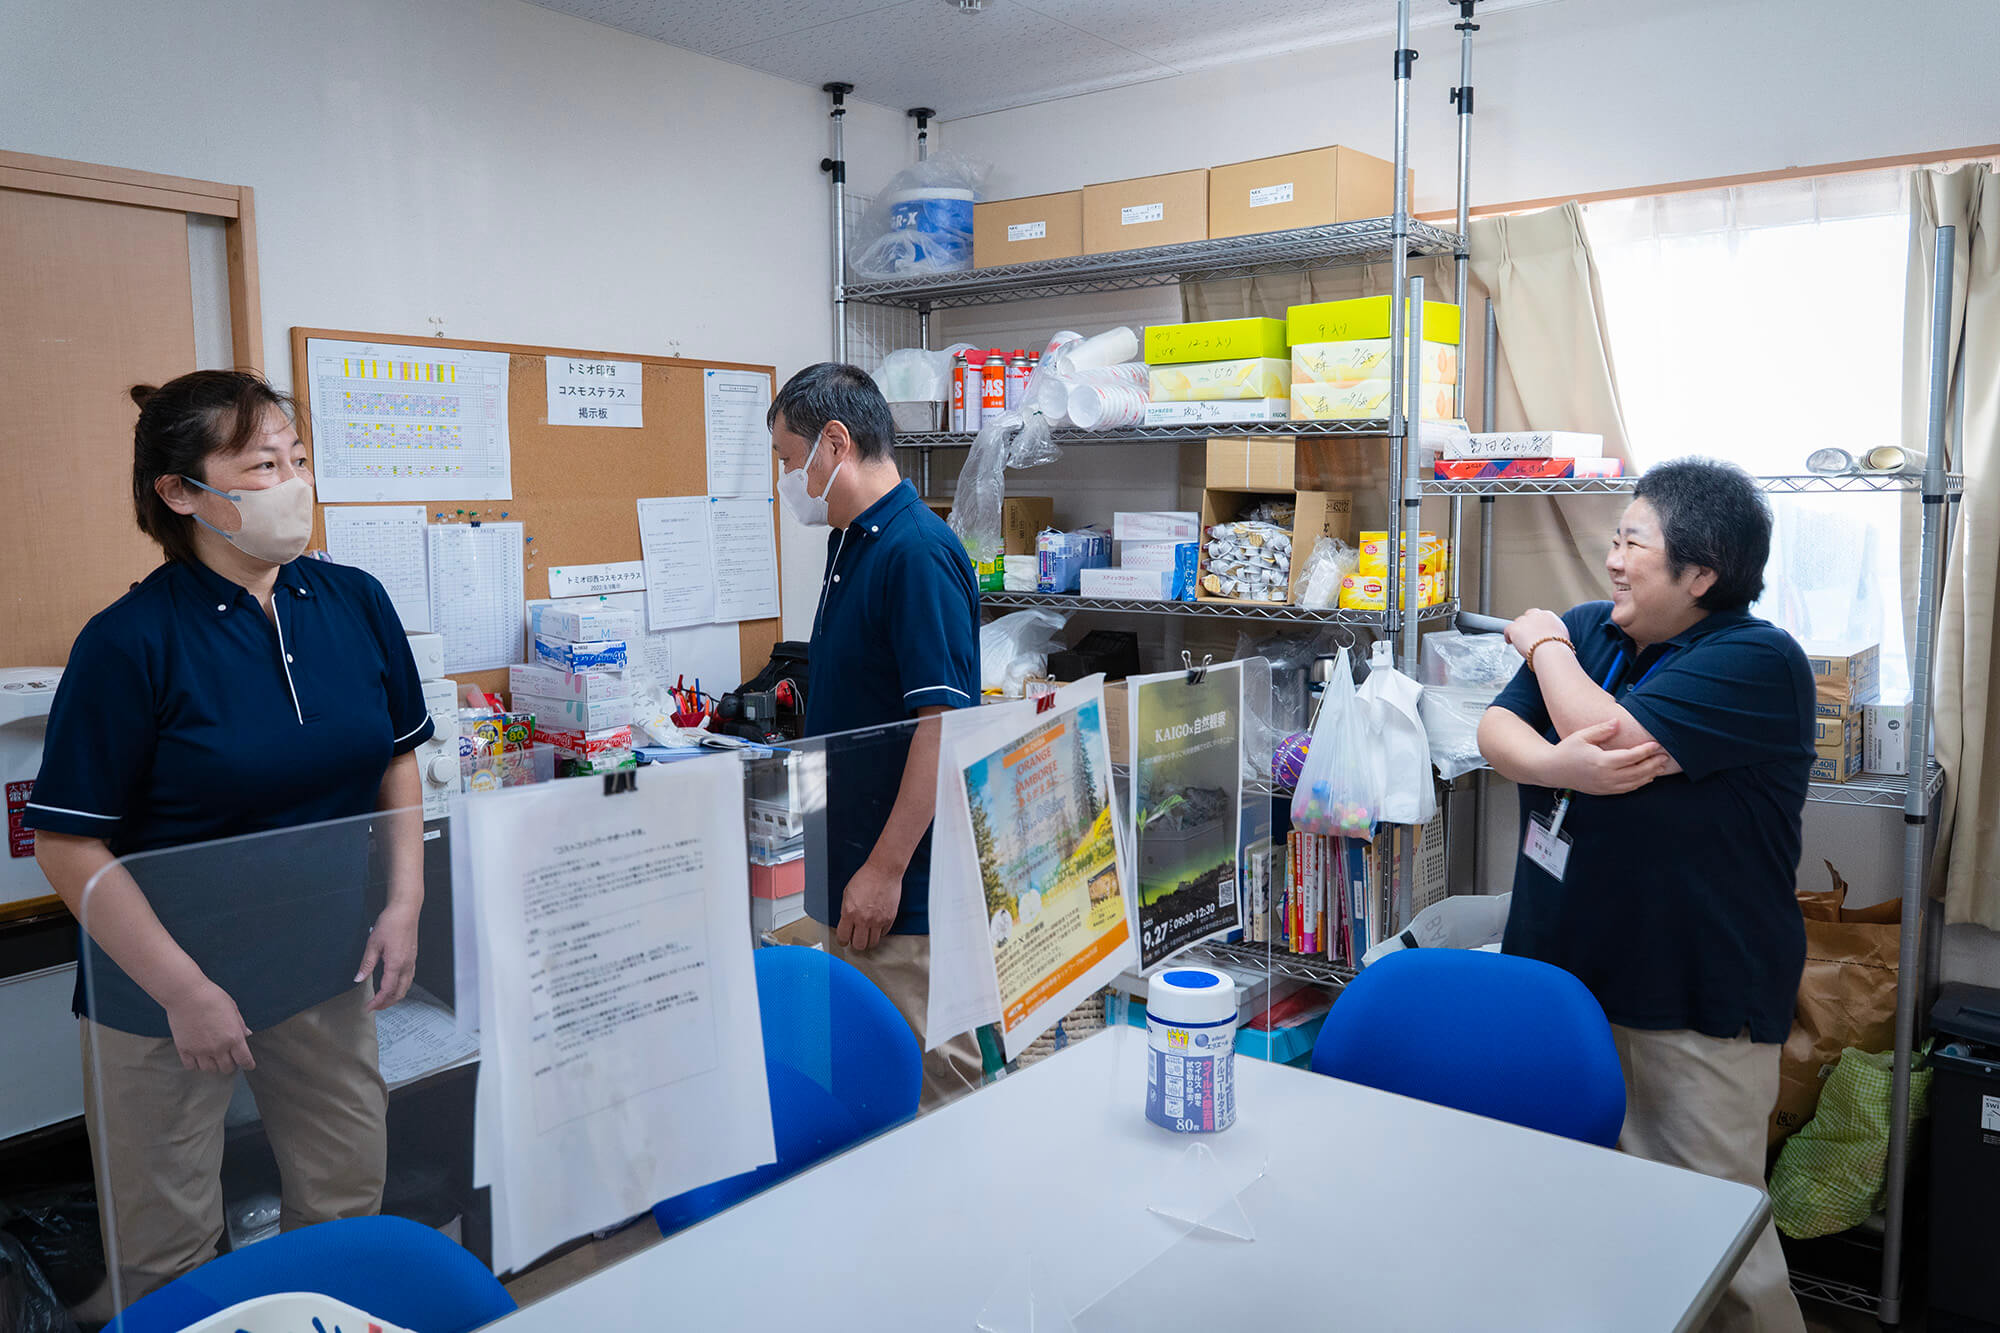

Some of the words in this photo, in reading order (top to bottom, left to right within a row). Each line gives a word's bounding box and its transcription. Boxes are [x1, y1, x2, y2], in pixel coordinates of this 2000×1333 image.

[568, 362, 616, 377] トミオ印西
[559, 386, 626, 398] コスモステラス
[578, 406, 608, 420] 掲示板
[567, 572, 641, 584] トミオ印西コスモステラス
[509, 730, 525, 740] 80
[1017, 746, 1051, 776] ORANGE
[1143, 921, 1169, 951] 9.27
[1173, 902, 1216, 929] 09:30-12:30
[1216, 1057, 1226, 1128] アルコールタオル
